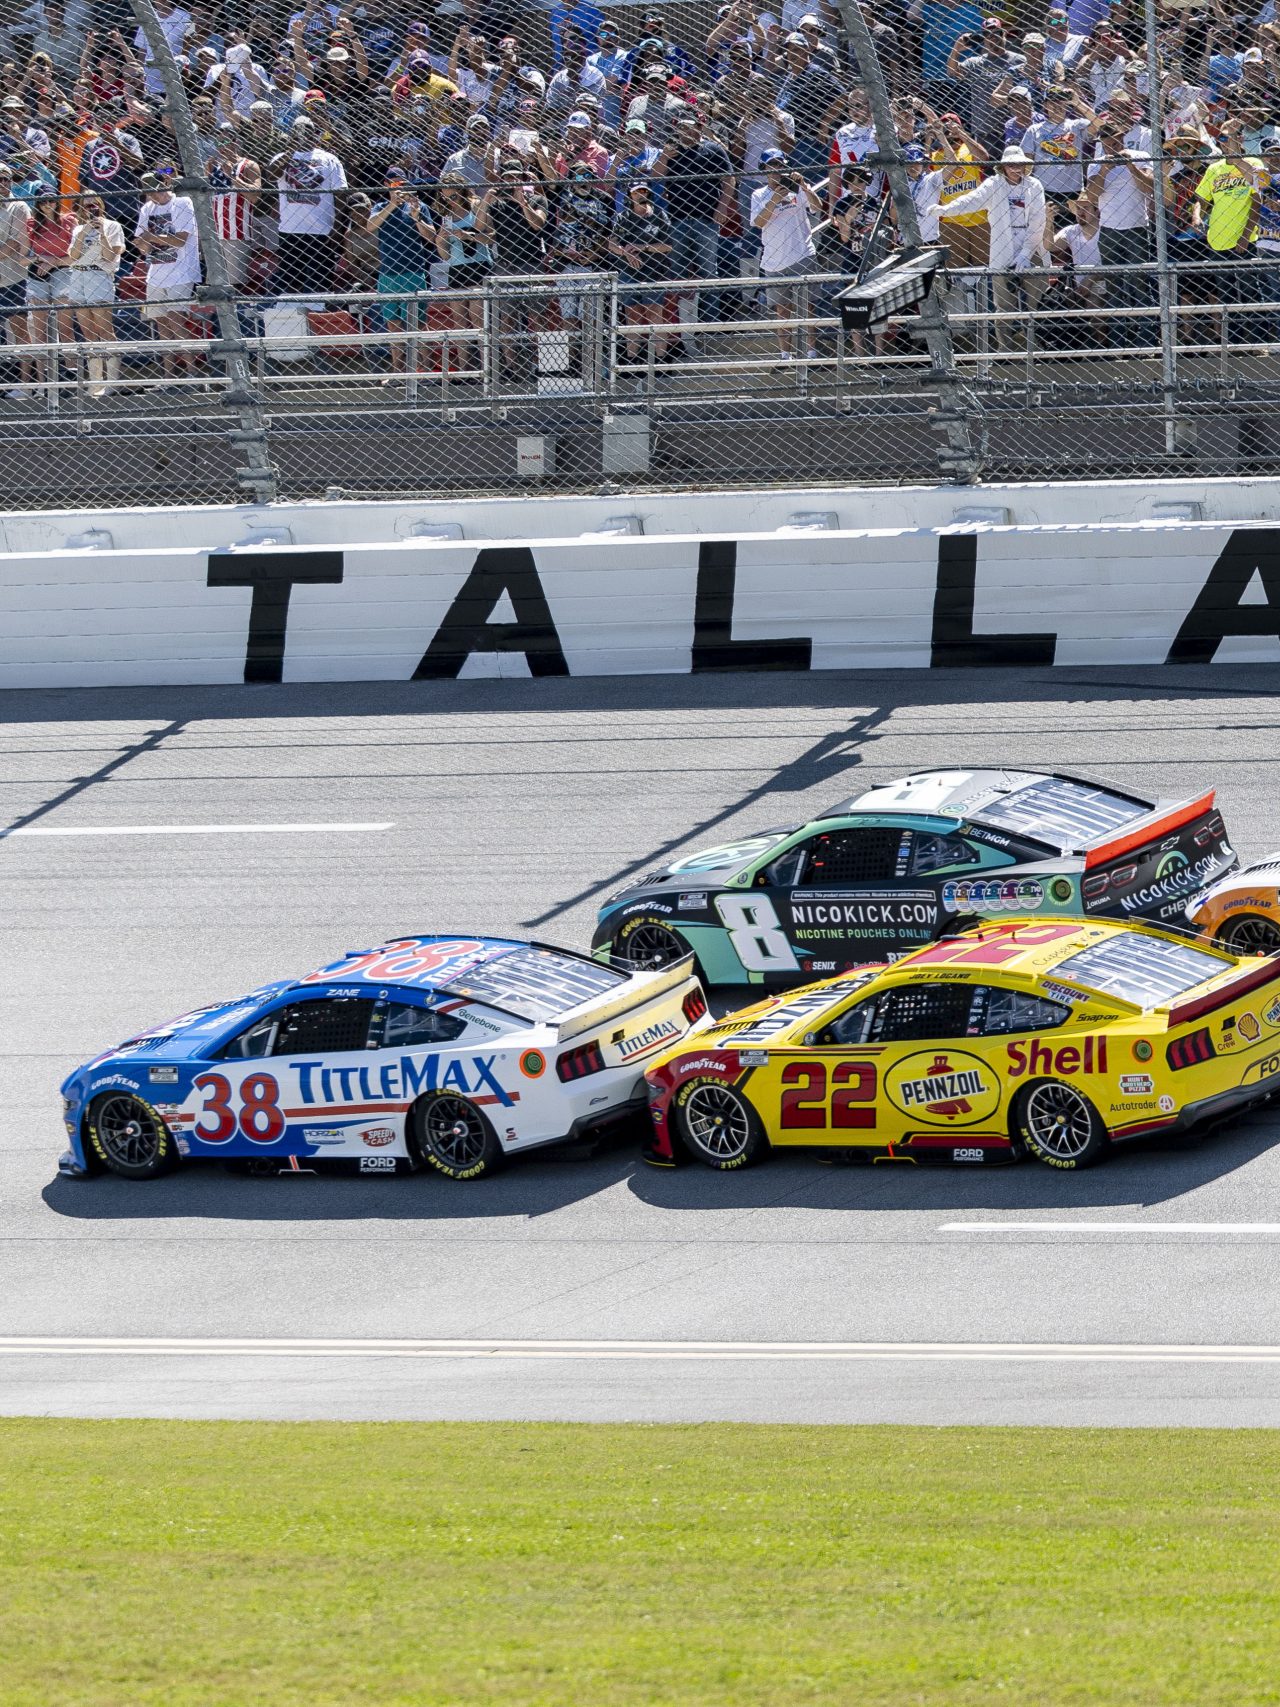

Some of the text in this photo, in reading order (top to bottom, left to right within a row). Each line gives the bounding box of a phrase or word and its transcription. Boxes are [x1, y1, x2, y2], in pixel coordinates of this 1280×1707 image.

[970, 826, 1011, 848] BETMGM
[1120, 853, 1223, 911] NICOKICK.COM
[622, 901, 674, 916] GOODYEAR
[1223, 896, 1272, 911] GOODYEAR
[791, 904, 938, 925] NICOKICK.COM
[714, 893, 800, 971] 8
[796, 929, 845, 939] NICOTINE
[848, 928, 896, 939] POUCHES
[812, 961, 837, 970] SENIX
[326, 989, 360, 998] ZANE
[1041, 980, 1090, 1001] DISCOUNT
[1050, 992, 1070, 1003] TIRE
[458, 1008, 501, 1034] Benebone
[1076, 1013, 1120, 1022] Snap-on
[1217, 1039, 1236, 1052] Crew
[1006, 1035, 1108, 1077] Shell
[680, 1058, 727, 1074] GOODYEAR
[91, 1073, 140, 1091] GOODYEAR
[901, 1070, 985, 1106] PENNZOIL
[678, 1075, 730, 1107] GOODYEAR
[780, 1061, 877, 1129] 22
[193, 1072, 286, 1145] 38
[1110, 1100, 1157, 1112] Autotrader
[368, 1129, 395, 1140] SPEEDY
[371, 1137, 395, 1147] CASH
[720, 1152, 747, 1169] EAGLE
[953, 1148, 984, 1157] FORD
[360, 1158, 396, 1167] FORD
